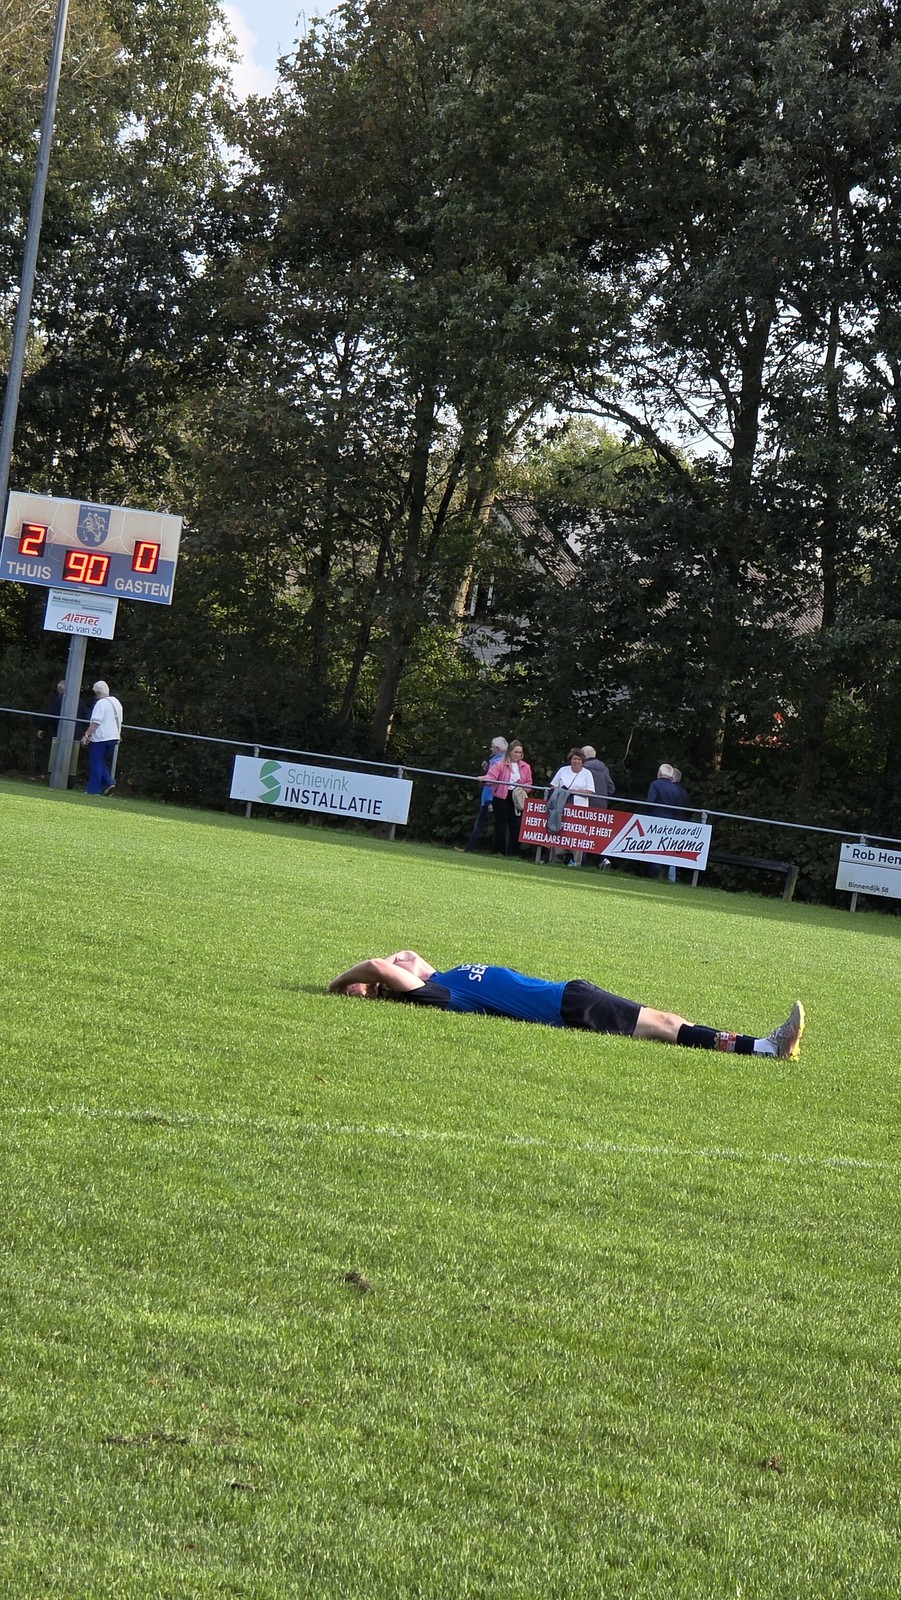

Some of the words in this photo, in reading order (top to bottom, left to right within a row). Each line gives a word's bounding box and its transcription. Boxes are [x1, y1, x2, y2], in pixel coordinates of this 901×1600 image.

[21, 526, 45, 556] 2
[134, 543, 159, 573] 0
[6, 561, 52, 580] THUIS
[64, 553, 109, 586] 90
[115, 577, 170, 598] GASTEN
[56, 622, 74, 631] Club
[76, 626, 90, 634] van
[92, 627, 102, 636] 50
[287, 768, 349, 792] Schievink
[284, 787, 383, 815] INSTALLATIE
[527, 802, 534, 813] JE
[563, 808, 597, 821] TBALCLUBS
[598, 812, 607, 823] EN
[607, 814, 614, 825] JE
[525, 816, 542, 828] HEBT
[561, 822, 588, 836] PERKERK,
[588, 826, 595, 836] JE
[596, 827, 613, 838] HEBT
[646, 824, 702, 839] Makelaardij
[523, 830, 560, 845] MAKELAARS
[561, 837, 570, 847] EN
[570, 838, 577, 848] JE
[577, 839, 595, 850] HEBT:
[621, 837, 652, 853] Jaap
[657, 836, 704, 854] Kingma
[852, 848, 875, 861] Rob
